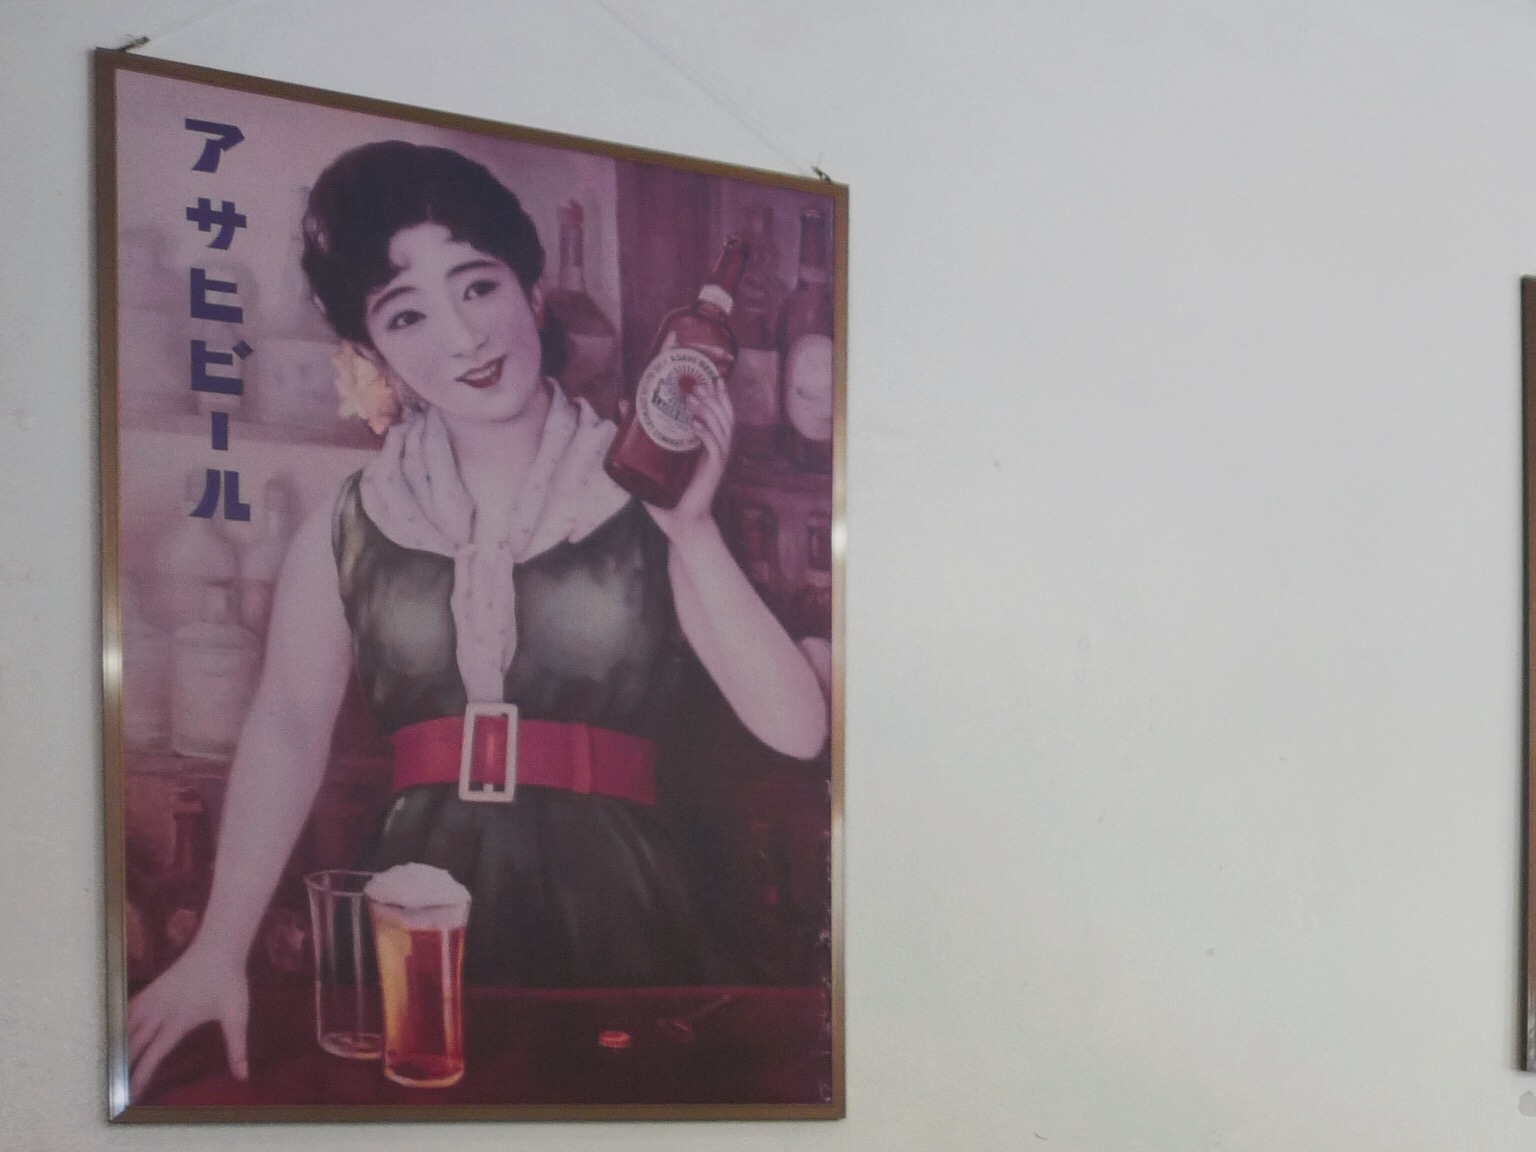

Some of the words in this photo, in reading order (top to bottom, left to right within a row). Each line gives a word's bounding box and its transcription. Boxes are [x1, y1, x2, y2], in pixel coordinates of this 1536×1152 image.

[185, 117, 253, 522] アサヒビール
